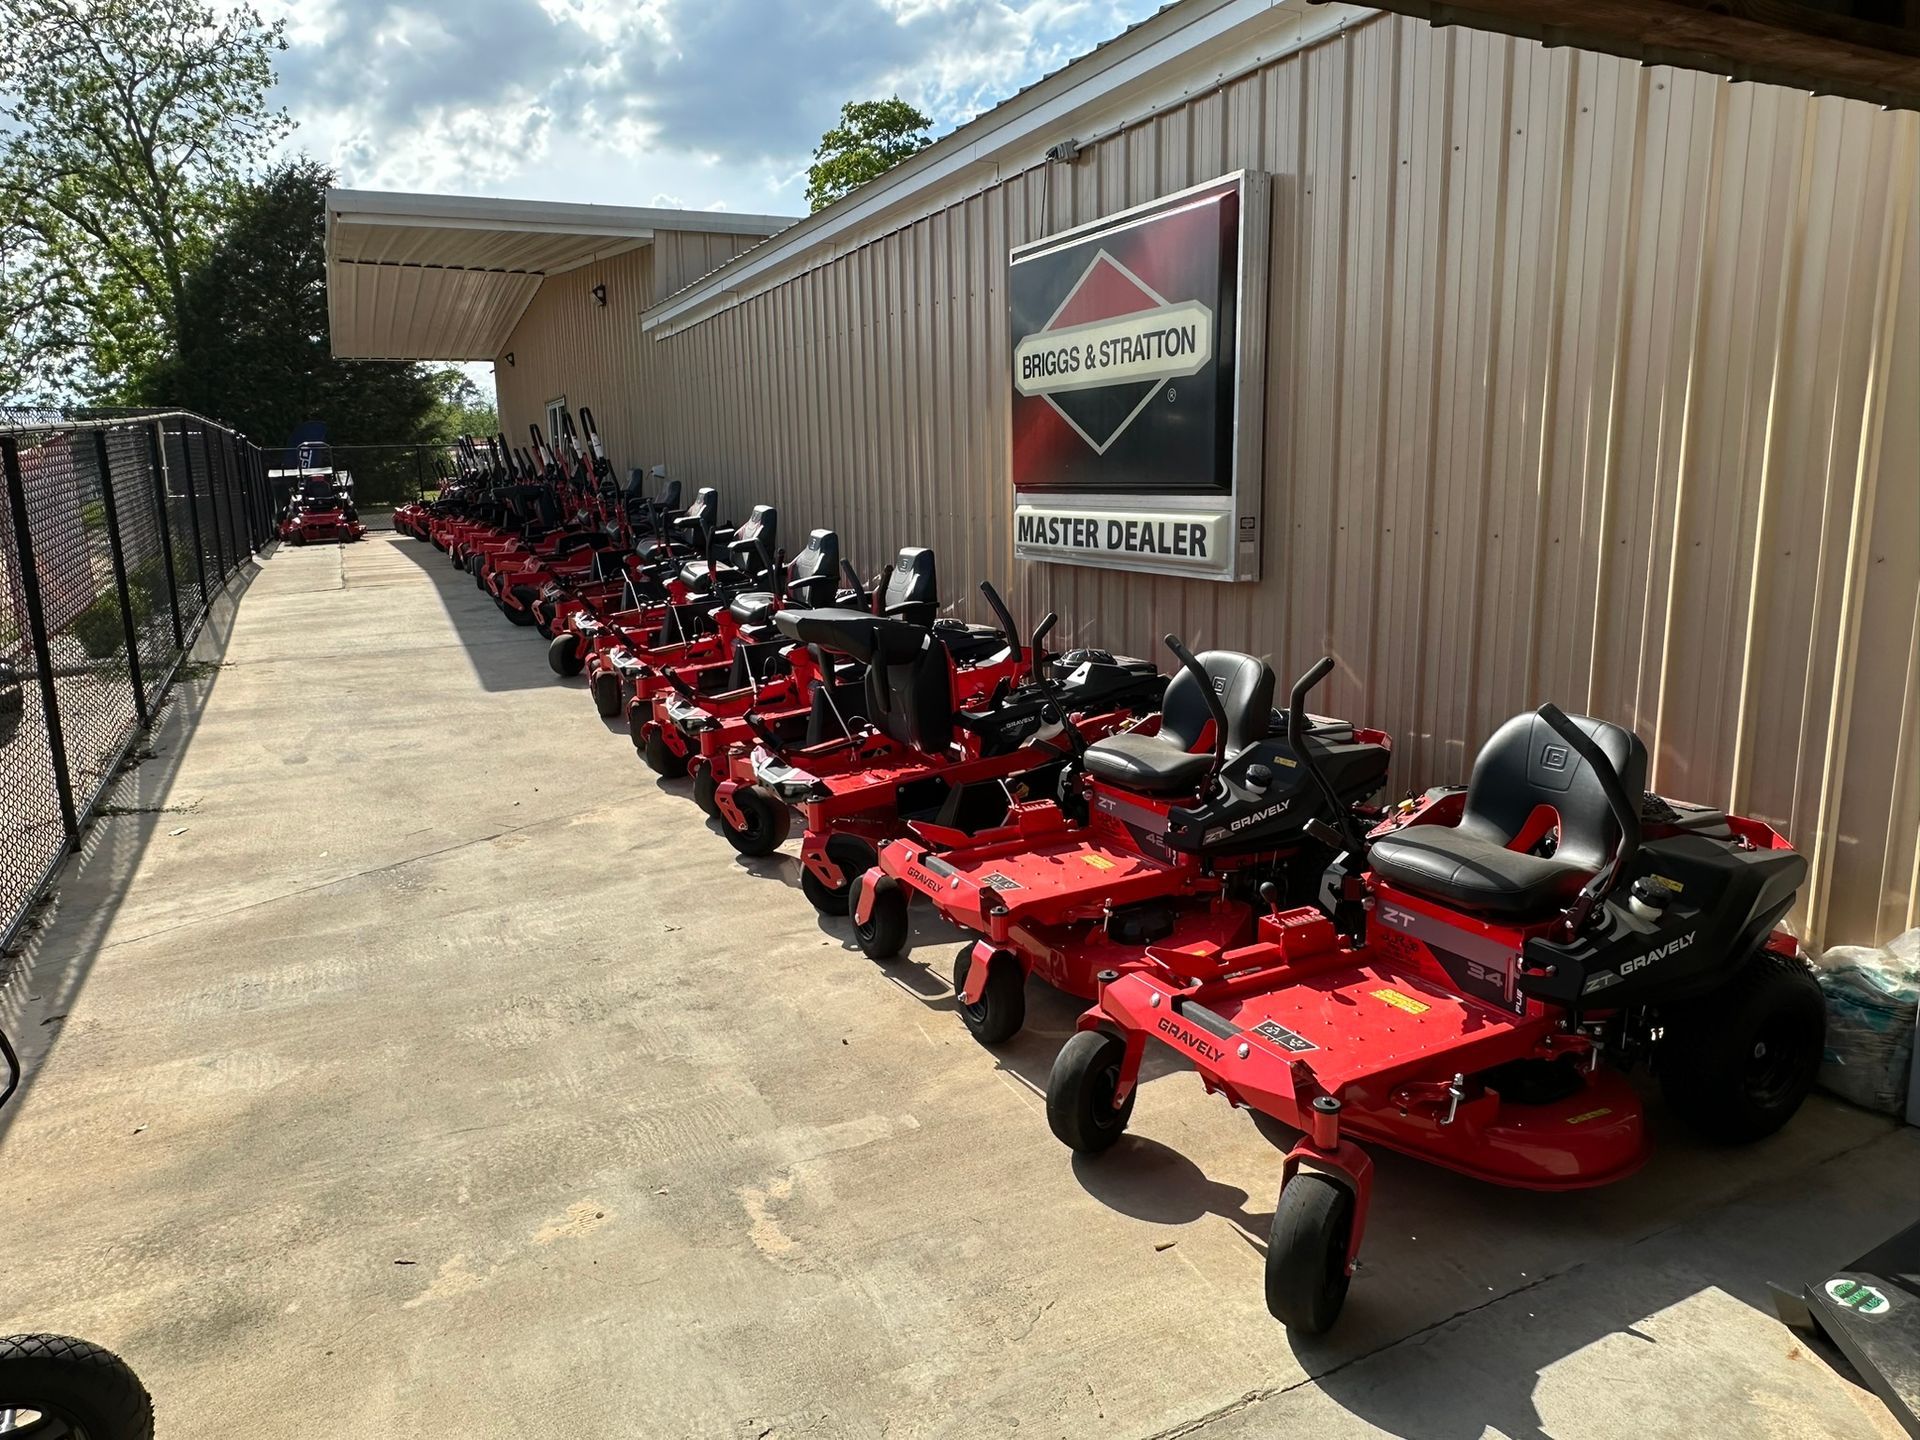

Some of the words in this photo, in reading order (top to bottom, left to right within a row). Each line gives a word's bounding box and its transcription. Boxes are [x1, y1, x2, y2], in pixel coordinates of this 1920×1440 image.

[1023, 346, 1080, 379] BRIGGS
[1085, 344, 1097, 370] &
[1100, 325, 1196, 367] STRATTON
[1018, 516, 1099, 548] MASTER
[1107, 520, 1207, 557] DEALER
[1098, 796, 1116, 811] ZT
[1230, 800, 1290, 831] GRAVELY
[1206, 829, 1226, 841] ZT
[907, 867, 943, 892] GRAVELY
[1383, 907, 1415, 927] ZT
[1620, 930, 1696, 975] GRAVELY
[1467, 961, 1503, 987] 34
[1586, 973, 1614, 992] ZT
[1157, 1017, 1224, 1062] GRAVELY
